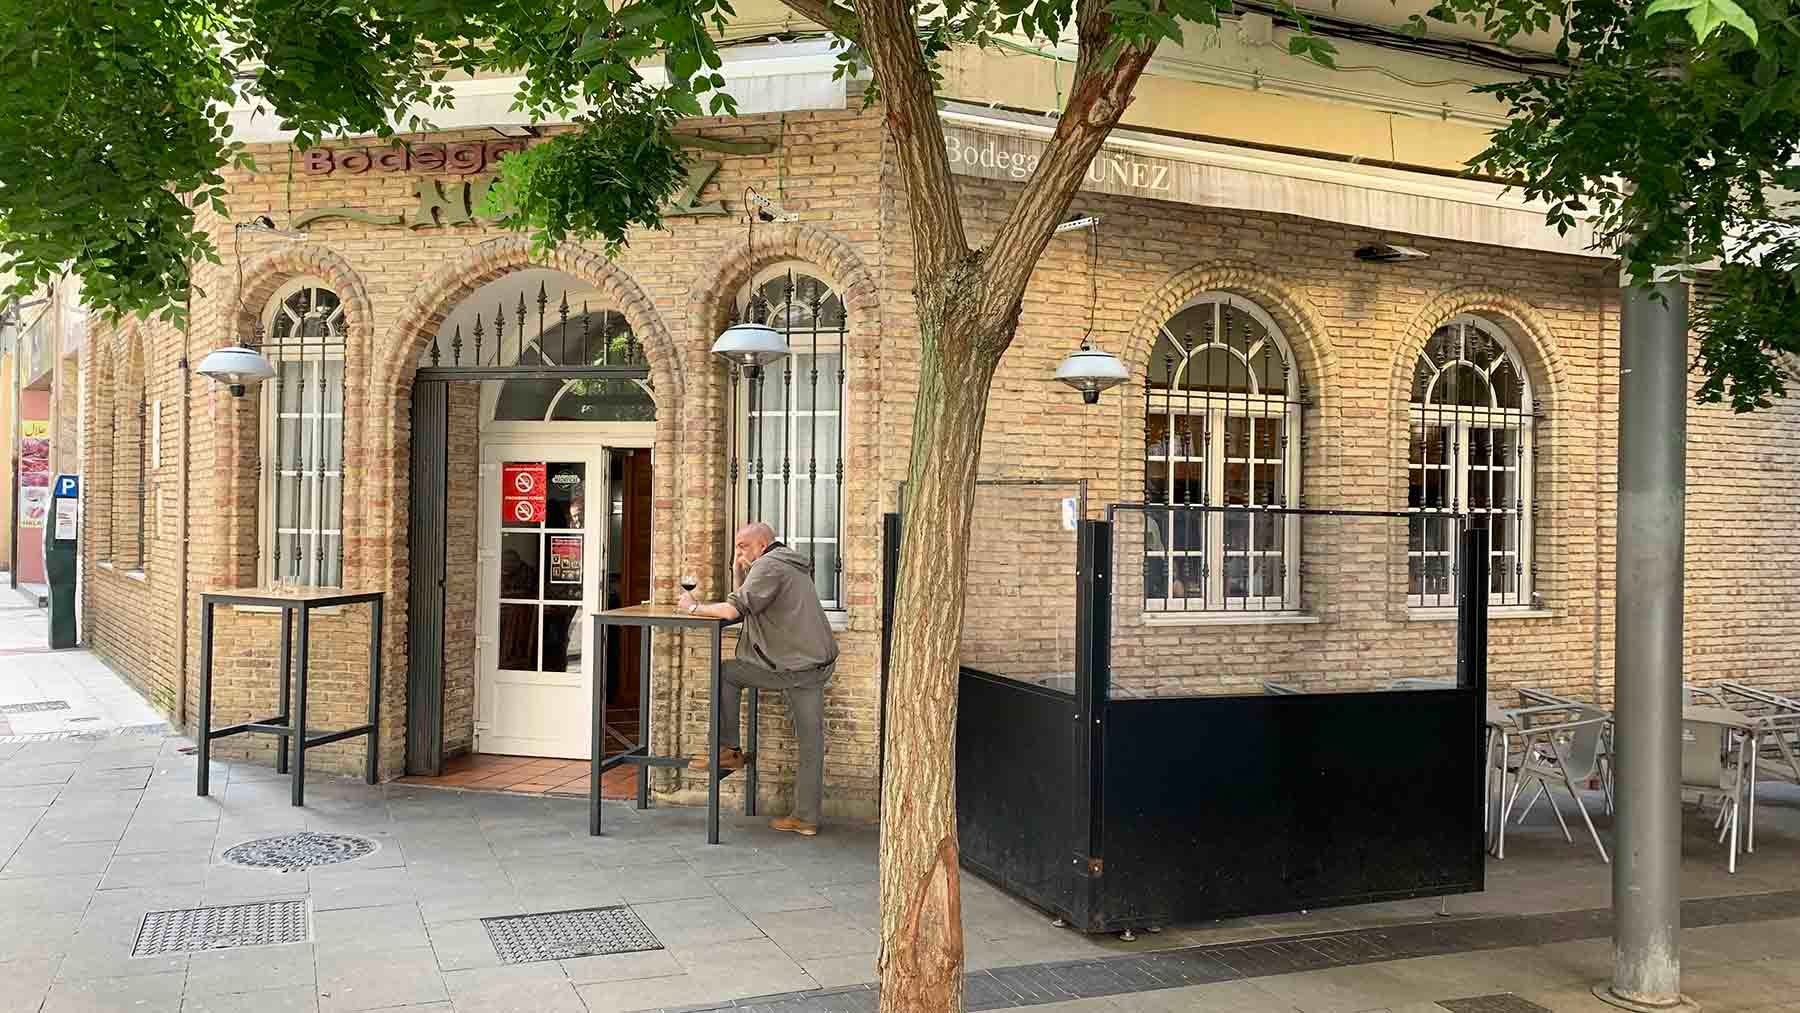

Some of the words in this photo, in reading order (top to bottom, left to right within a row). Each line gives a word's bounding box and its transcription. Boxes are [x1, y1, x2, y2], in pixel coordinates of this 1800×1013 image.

[944, 135, 1040, 178] Bodega
[1090, 150, 1170, 191] UÑEZ
[62, 478, 75, 495] P
